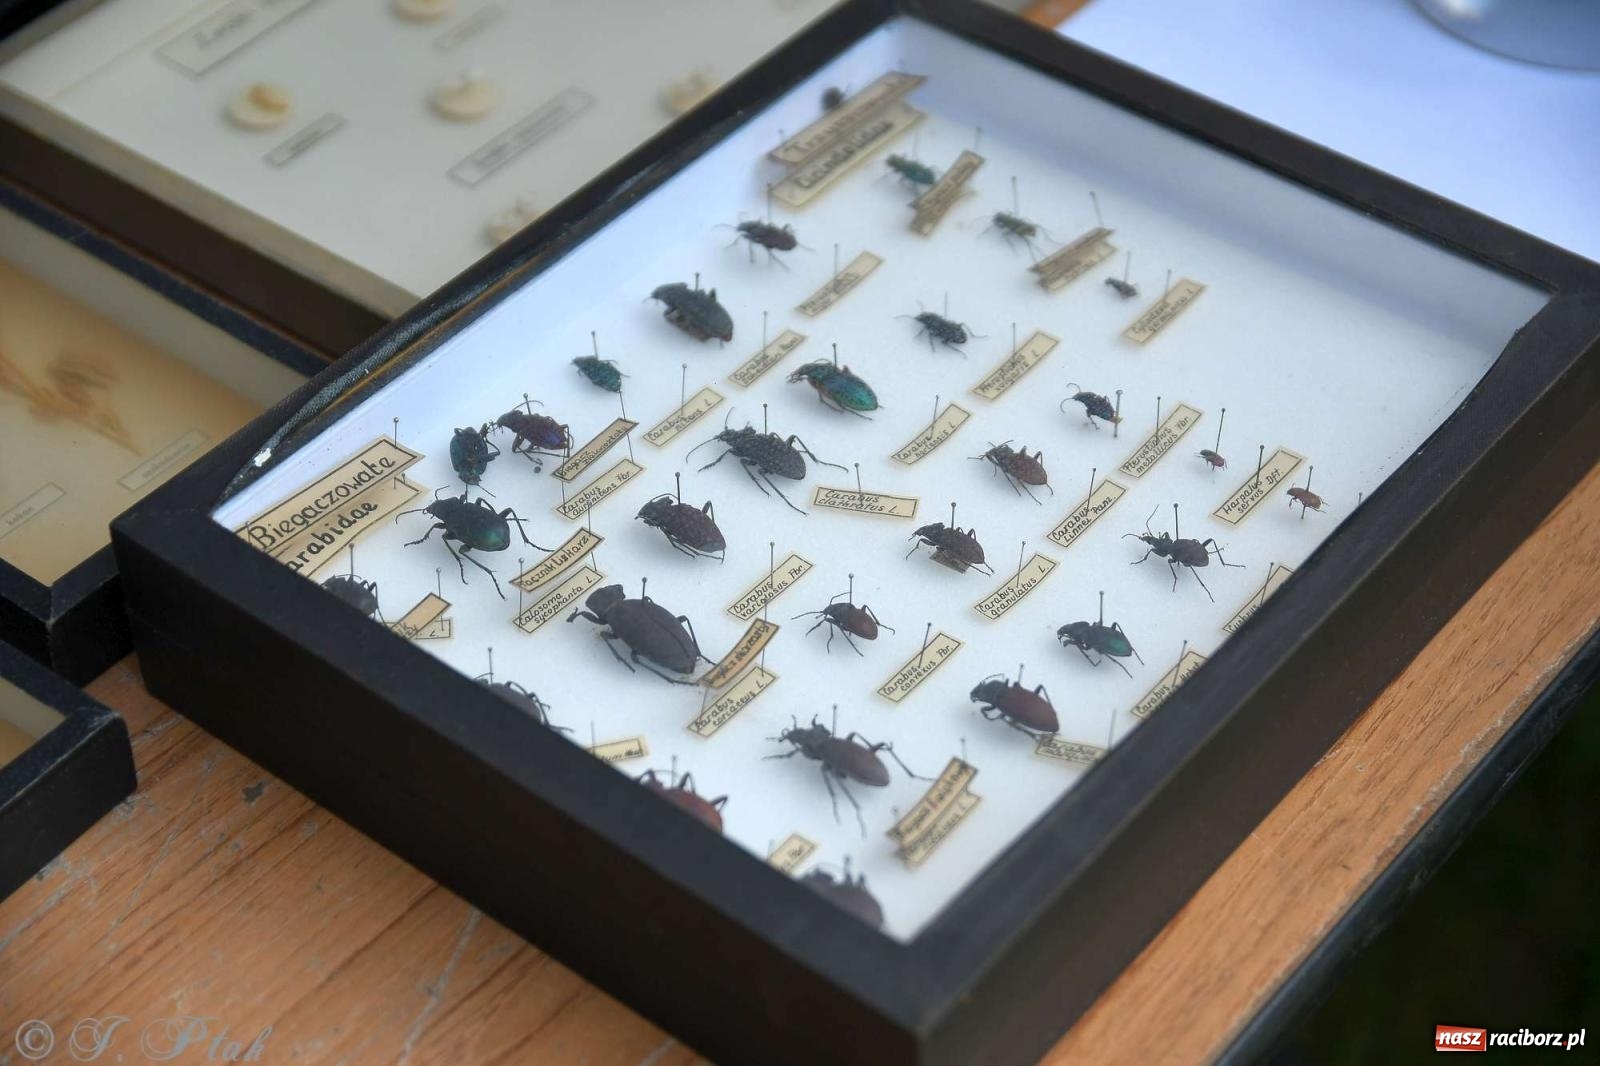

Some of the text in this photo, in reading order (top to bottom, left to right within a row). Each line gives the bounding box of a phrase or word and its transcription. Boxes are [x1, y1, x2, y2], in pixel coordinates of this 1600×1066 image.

[249, 456, 396, 549] Biegaczowate
[563, 484, 602, 514] Carabus
[816, 497, 885, 513] clathratus
[825, 488, 880, 503] Carabus
[284, 501, 379, 573] arabidae
[1051, 506, 1090, 541] Carabus
[519, 592, 563, 626] Calosoma
[534, 585, 584, 625] sycophanta
[733, 581, 773, 614] Carabus
[979, 586, 1015, 613] Carabus
[991, 577, 1037, 618] granulatus
[883, 665, 918, 696] Carabus
[900, 660, 937, 692] convexus
[1136, 685, 1170, 714] Carabus
